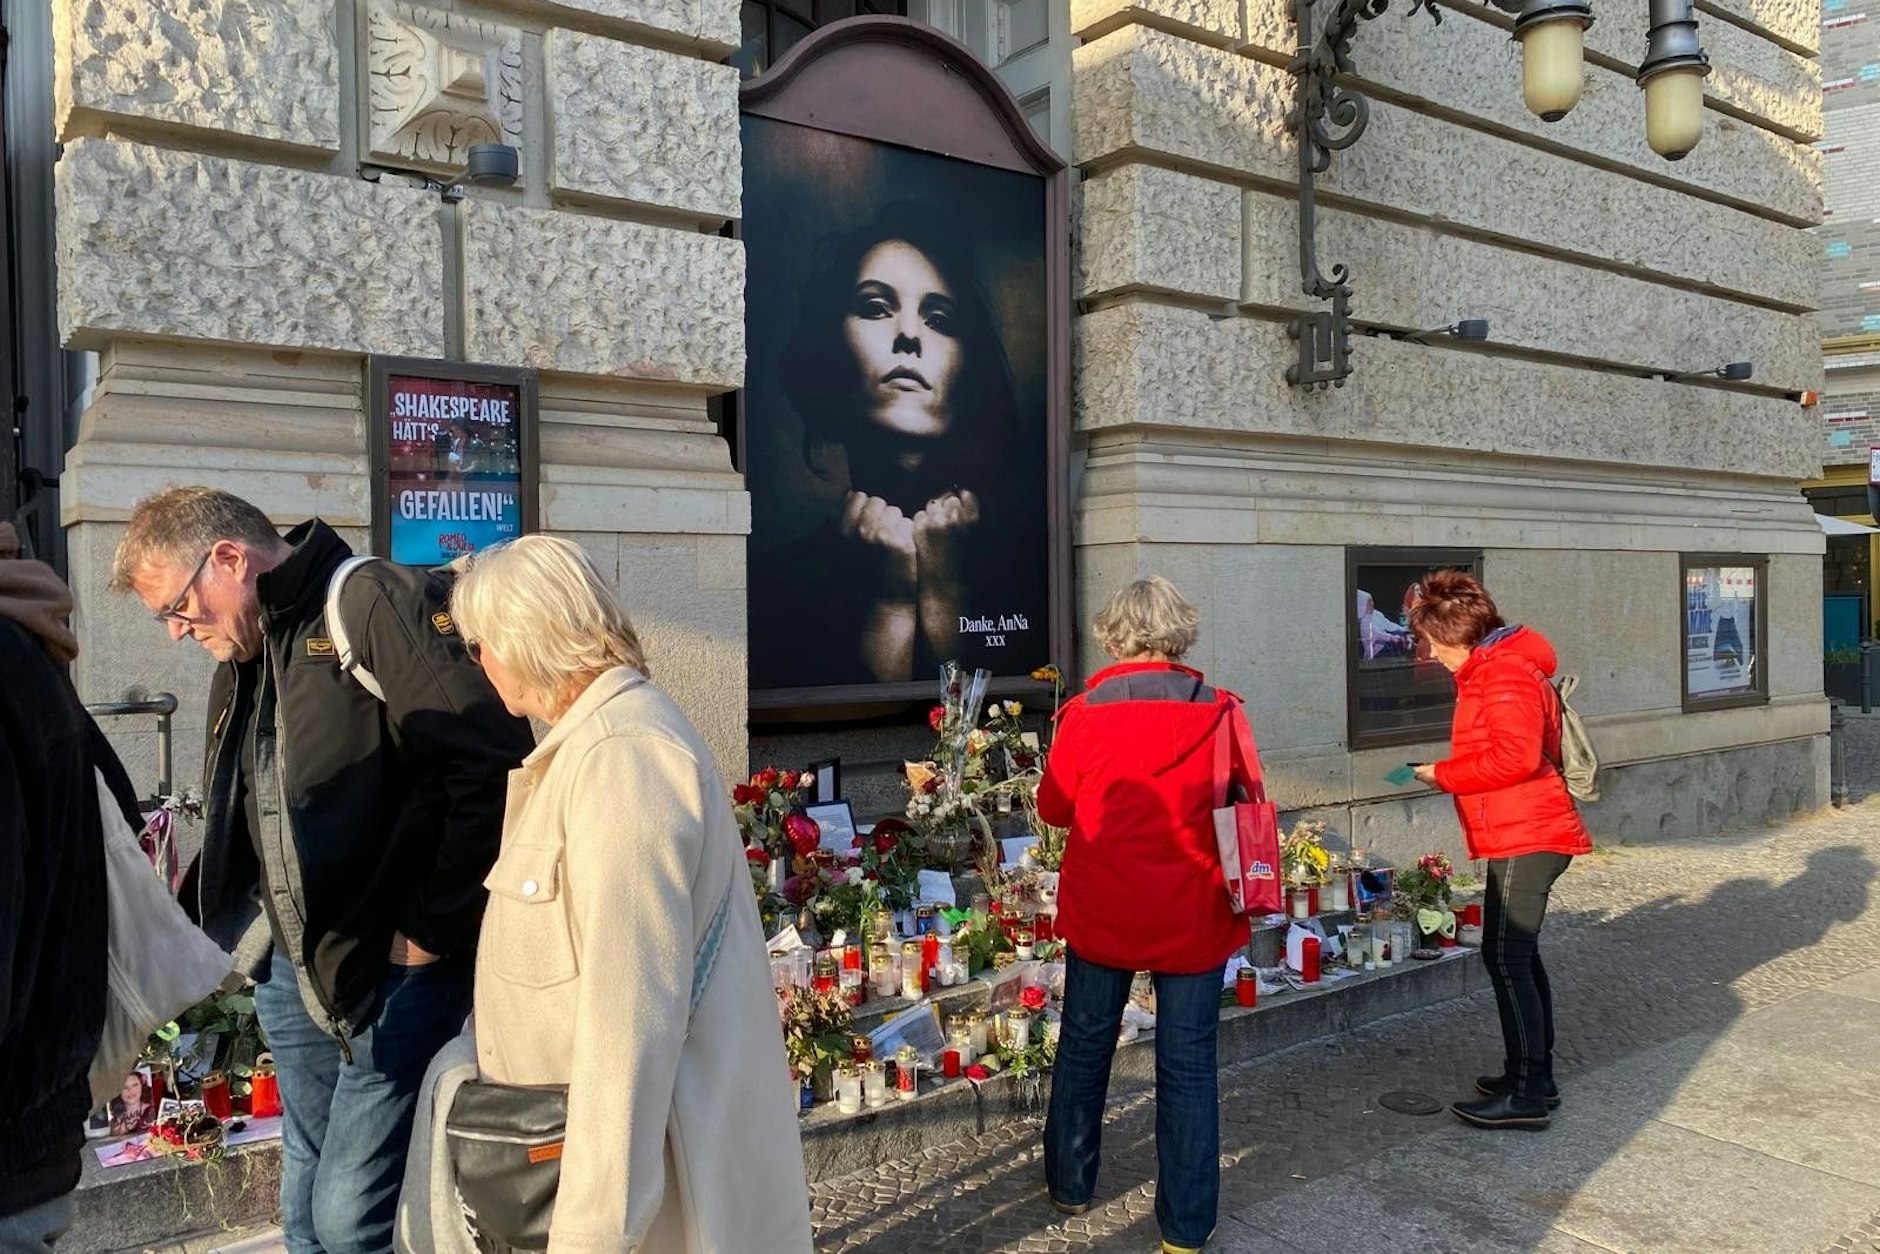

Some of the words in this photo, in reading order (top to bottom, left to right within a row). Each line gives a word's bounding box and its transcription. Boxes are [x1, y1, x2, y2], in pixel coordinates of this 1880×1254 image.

[497, 524, 513, 532] WELT
[959, 615, 996, 633] Danke,
[997, 614, 1029, 631] AnNa
[1252, 862, 1269, 873] dm
